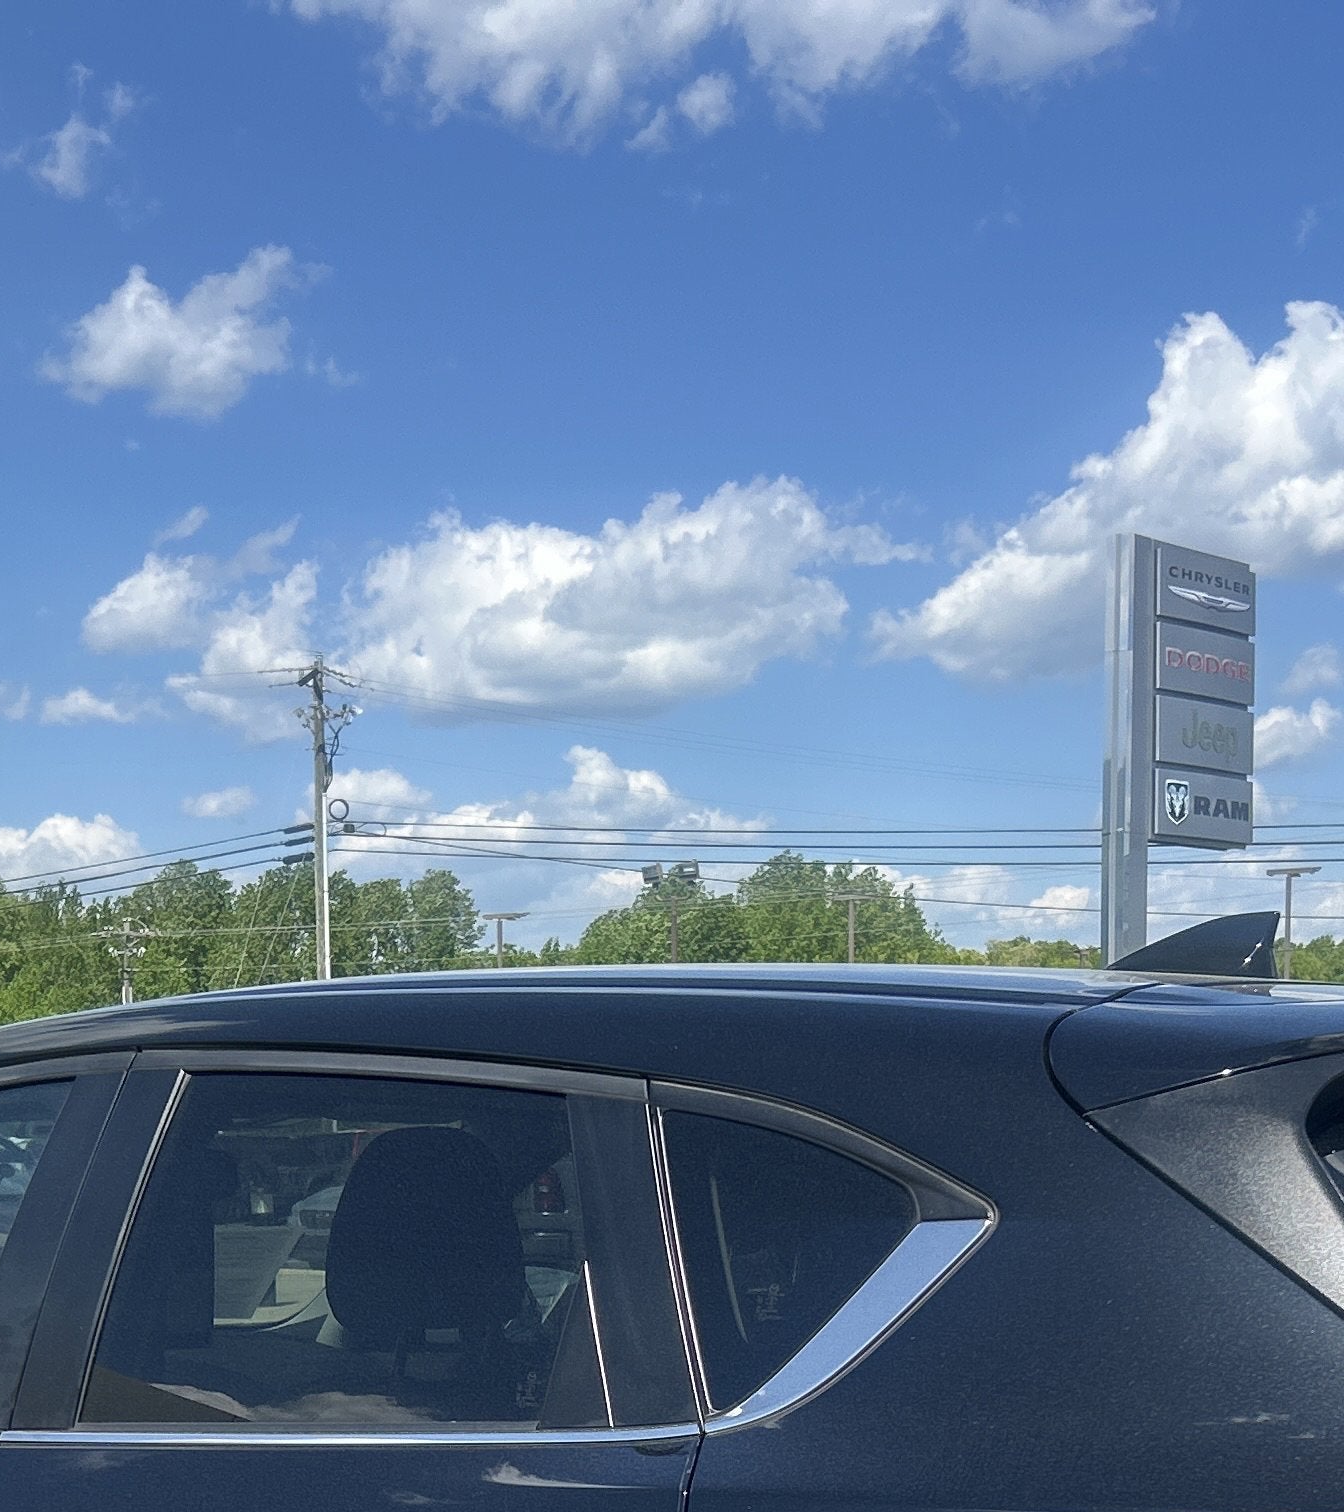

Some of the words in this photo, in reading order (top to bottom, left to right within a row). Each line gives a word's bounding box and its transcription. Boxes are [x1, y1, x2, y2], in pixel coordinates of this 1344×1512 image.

[1168, 566, 1250, 596] CHRYSLER
[1165, 646, 1249, 682] DODGE
[1182, 709, 1239, 762] Jeep
[1193, 795, 1249, 822] RAM
